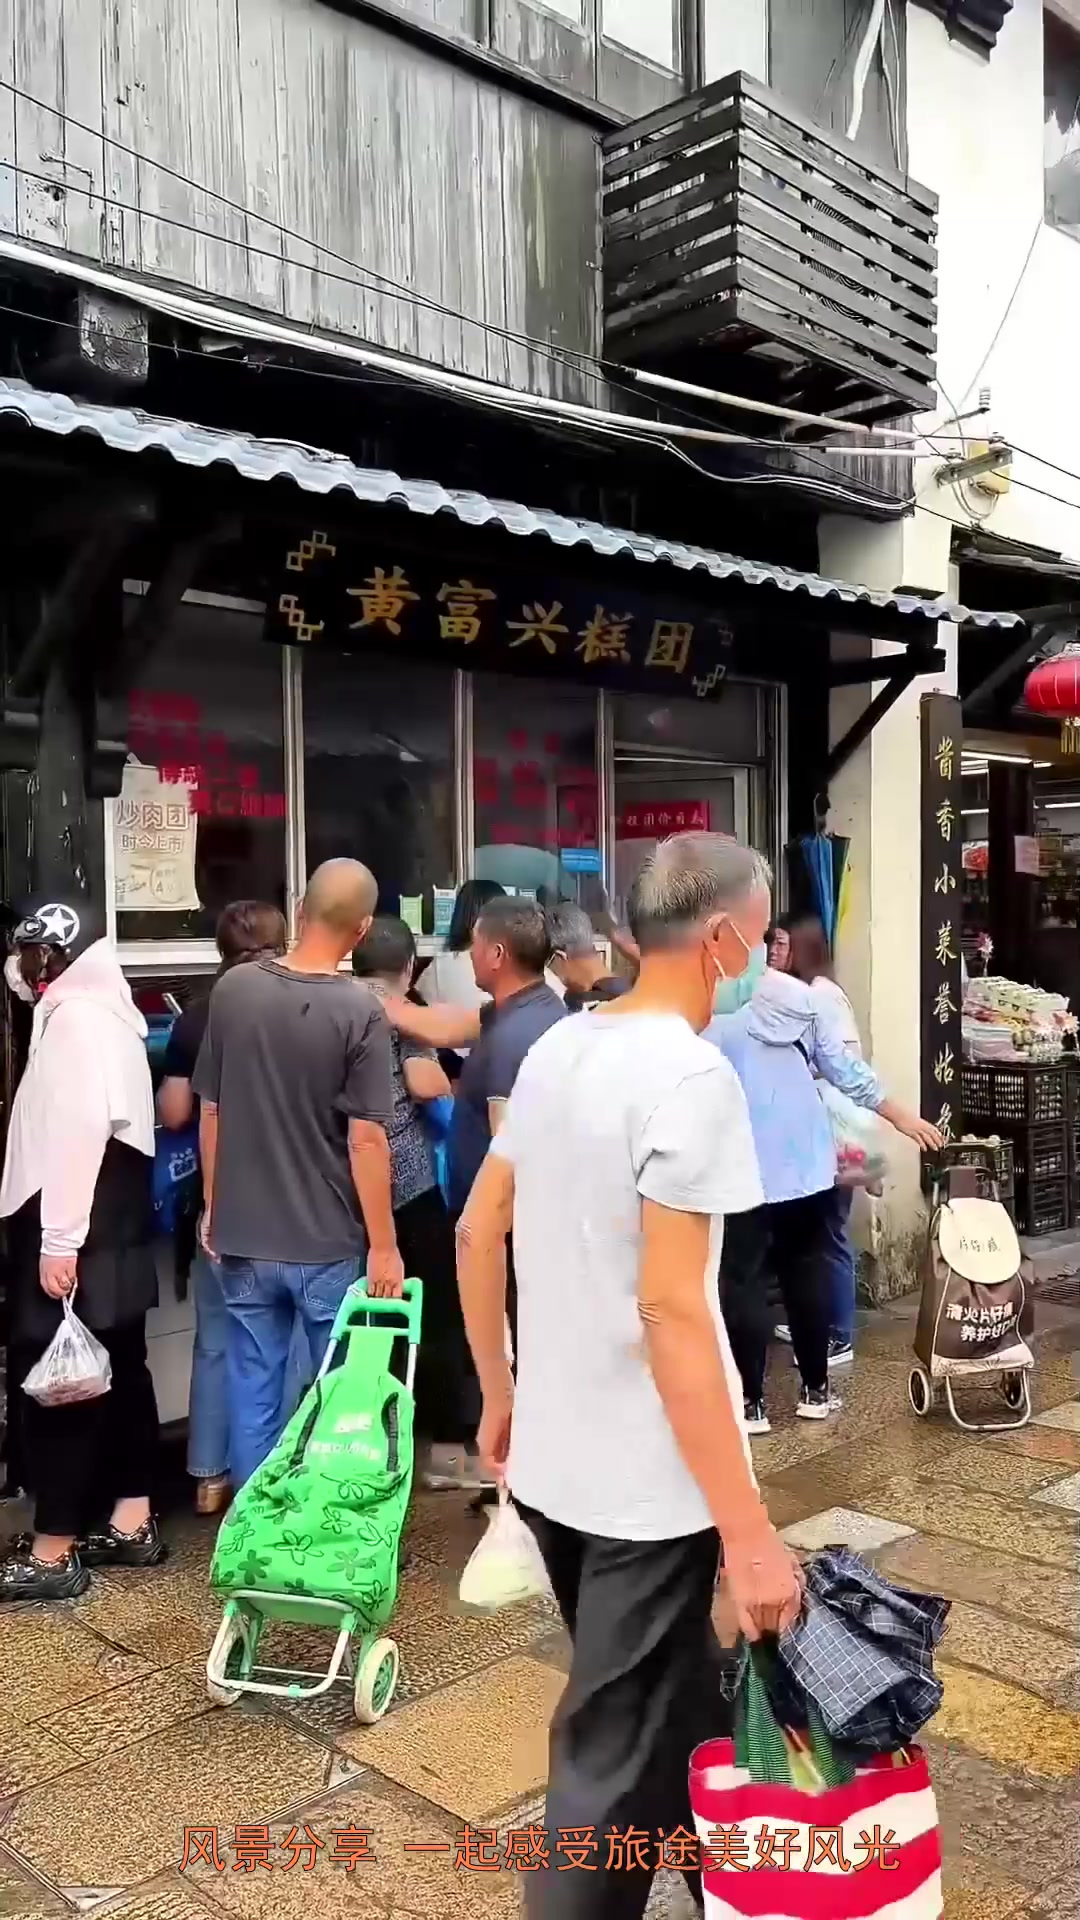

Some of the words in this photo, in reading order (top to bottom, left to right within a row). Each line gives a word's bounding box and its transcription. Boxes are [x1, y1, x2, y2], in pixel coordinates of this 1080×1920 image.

[346, 566, 695, 673] 黄富兴糕团
[117, 800, 188, 830] 炒肉团
